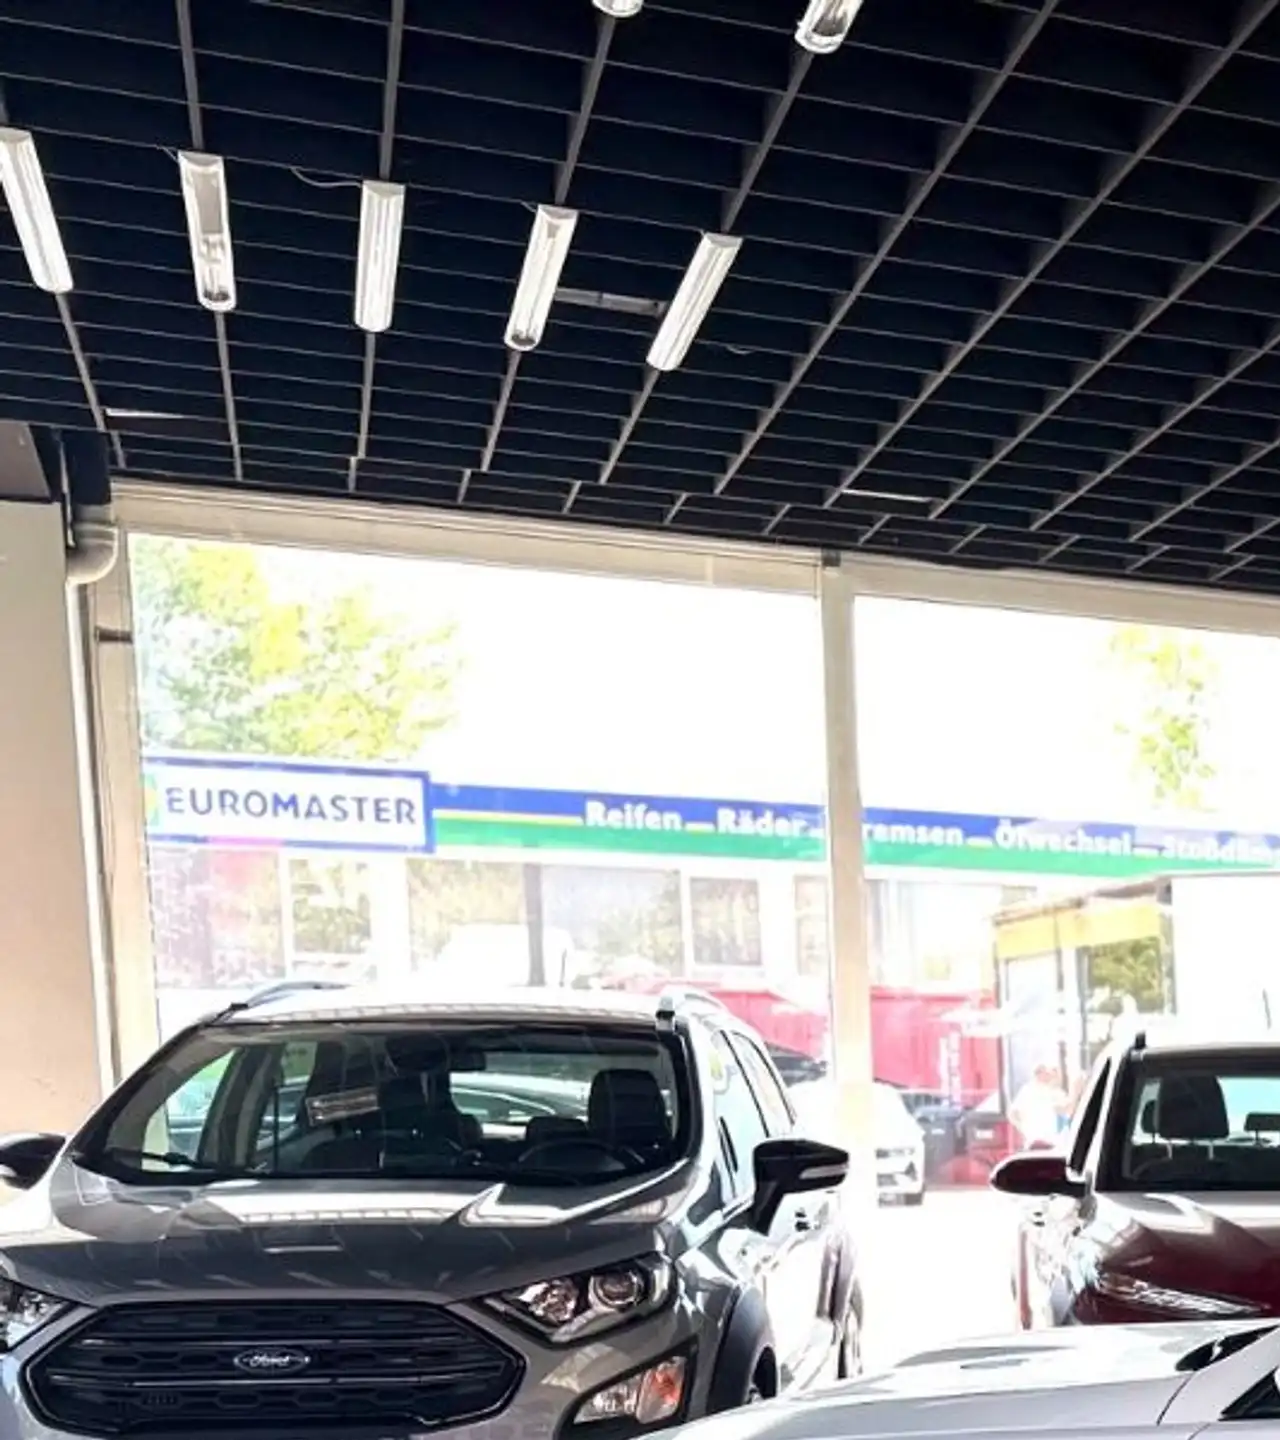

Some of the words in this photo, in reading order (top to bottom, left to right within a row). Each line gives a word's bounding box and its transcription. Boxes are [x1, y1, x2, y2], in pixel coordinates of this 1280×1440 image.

[165, 786, 417, 825] EUROMASTER
[585, 800, 683, 832] Reifen
[716, 807, 808, 838] Räder
[863, 822, 964, 847] remsen
